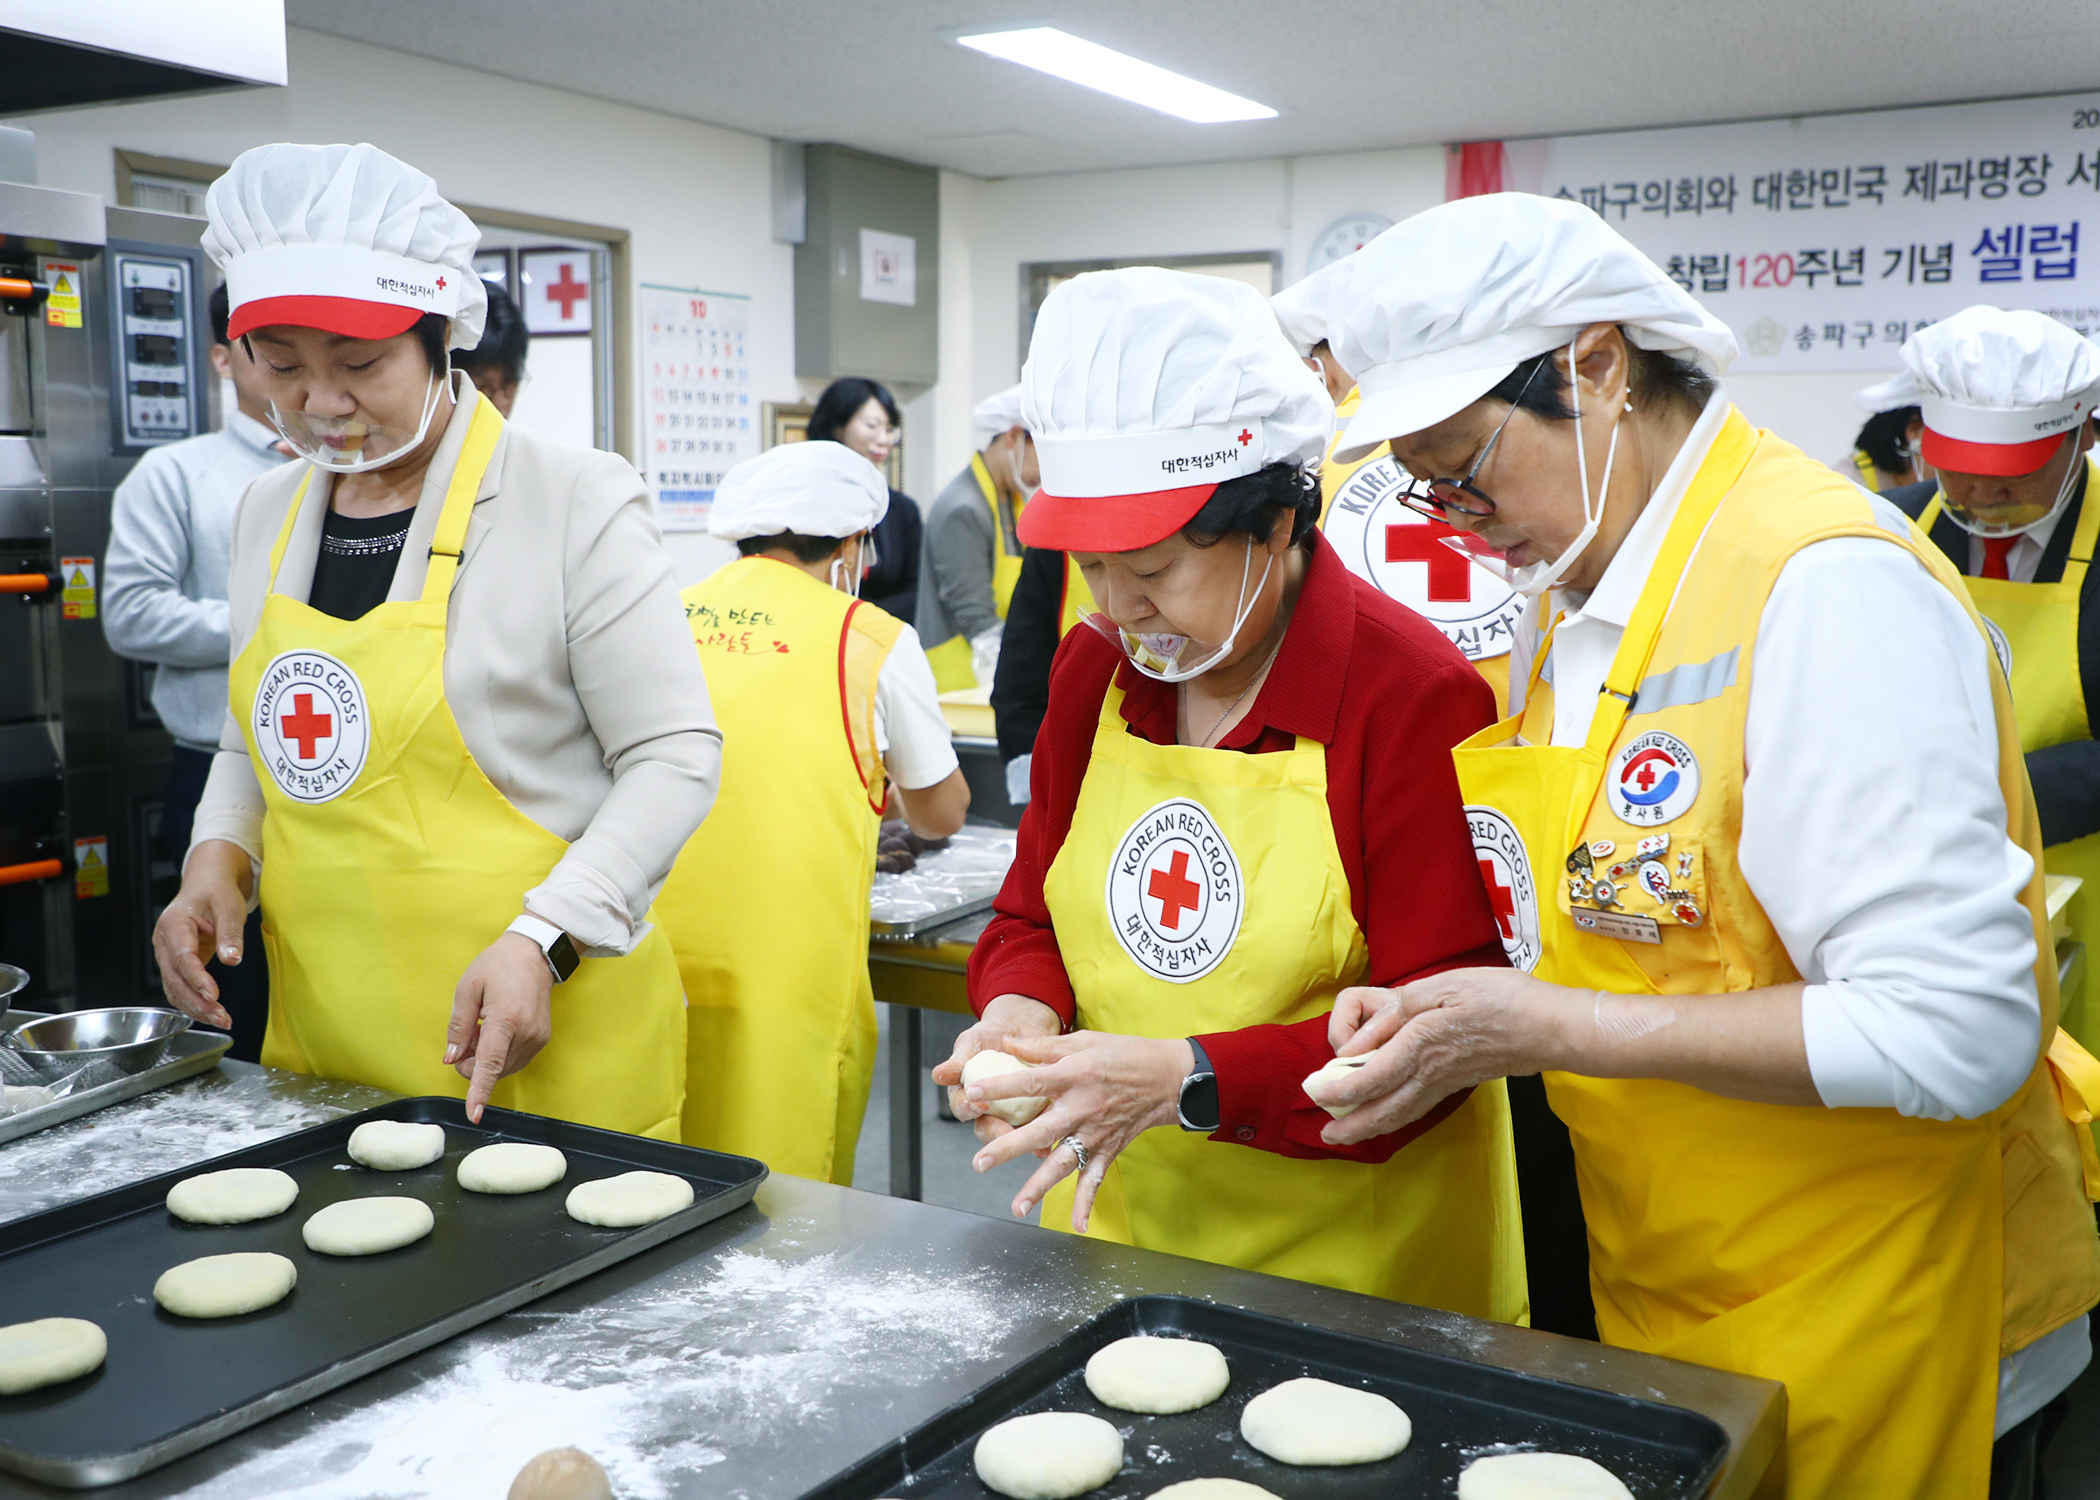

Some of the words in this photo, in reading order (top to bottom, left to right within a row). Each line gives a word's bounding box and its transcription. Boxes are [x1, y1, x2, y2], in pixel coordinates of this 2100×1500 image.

[1753, 165, 1888, 212] 대한민국
[1903, 152, 2053, 202] 제과명장
[1667, 245, 1866, 293] 창립120주년
[1881, 240, 1954, 286] 기념
[1971, 220, 2080, 284] 셀럽
[376, 277, 435, 299] 대한적십자사
[690, 299, 708, 320] 10
[1161, 448, 1239, 474] 대한적십자사
[260, 665, 291, 728] KOREAN
[293, 661, 325, 679] RED
[326, 671, 359, 725] CROSS
[276, 756, 351, 793] 대한적십자사
[1122, 813, 1175, 876] KOREAN
[1178, 813, 1203, 839] RED
[1202, 835, 1232, 903] CROSS
[1501, 833, 1530, 902] CROSS
[1126, 912, 1213, 970] 대한적십자사
